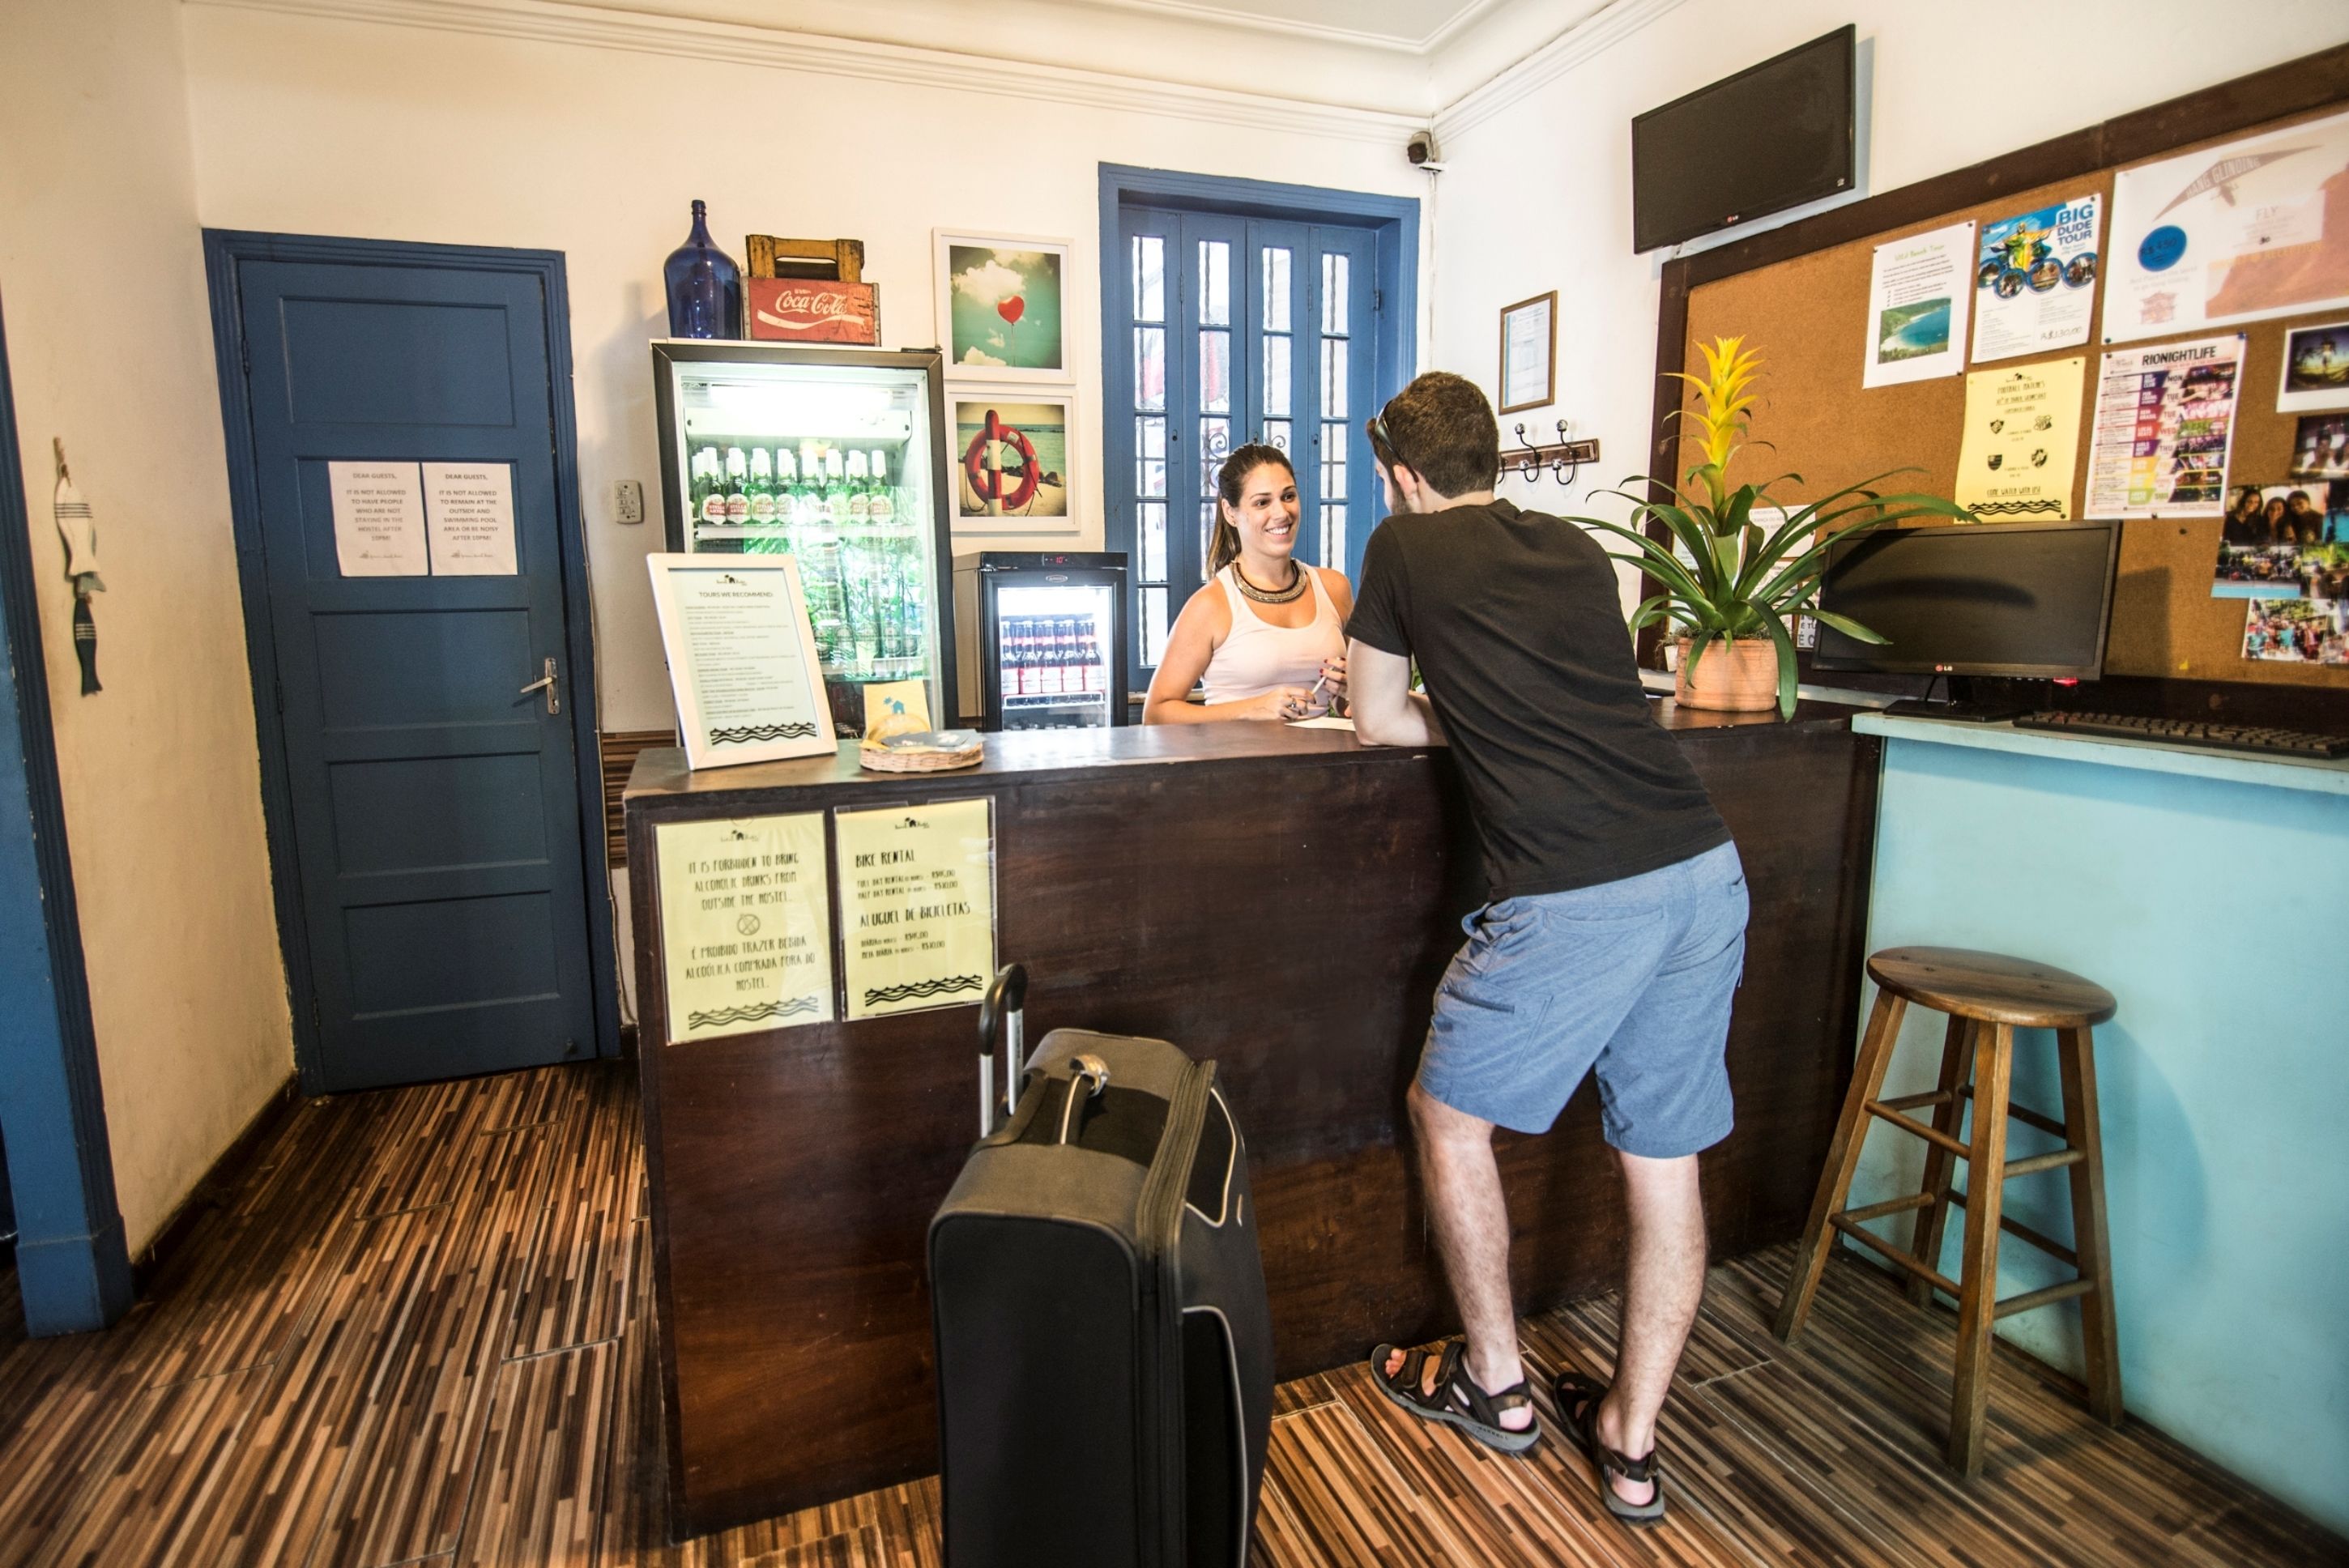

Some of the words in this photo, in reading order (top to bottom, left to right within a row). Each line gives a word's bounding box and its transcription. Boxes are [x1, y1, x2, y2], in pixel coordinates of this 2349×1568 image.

[2059, 204, 2093, 224] BIG
[2256, 206, 2279, 220] FLY
[2057, 219, 2092, 236] DUDE
[2058, 230, 2091, 245] TOUR
[2142, 346, 2216, 365] RIONIGHTLIFE
[1799, 632, 1804, 646] É
[688, 861, 697, 874] IT
[701, 861, 710, 873] IS
[714, 856, 757, 871] FORBIDDEN
[761, 855, 771, 867] TO
[775, 853, 799, 865] BRING
[855, 854, 876, 868] BIKE
[881, 850, 915, 864] RENTAL
[695, 877, 737, 893] ALCOHOLIC
[742, 873, 771, 888] DRINKS
[775, 871, 797, 884] FROM
[858, 880, 869, 888] FULL
[872, 878, 883, 886] DAY
[885, 876, 904, 884] RENTAL
[885, 888, 904, 896] RENTAL
[701, 895, 735, 911] OUTSIDE
[740, 894, 753, 906] THE
[860, 910, 900, 928] ALUGUEL
[906, 909, 915, 922] DE
[920, 901, 970, 919] BICICLETAS
[691, 947, 697, 960] É
[701, 943, 739, 958] PROIBIDO
[742, 939, 775, 953] TRAZER
[778, 935, 807, 949] BEBIDA
[734, 957, 778, 974] COMPRADA
[781, 955, 801, 967] FORA
[805, 952, 816, 964] DO
[736, 977, 770, 991] HOSTEL.
